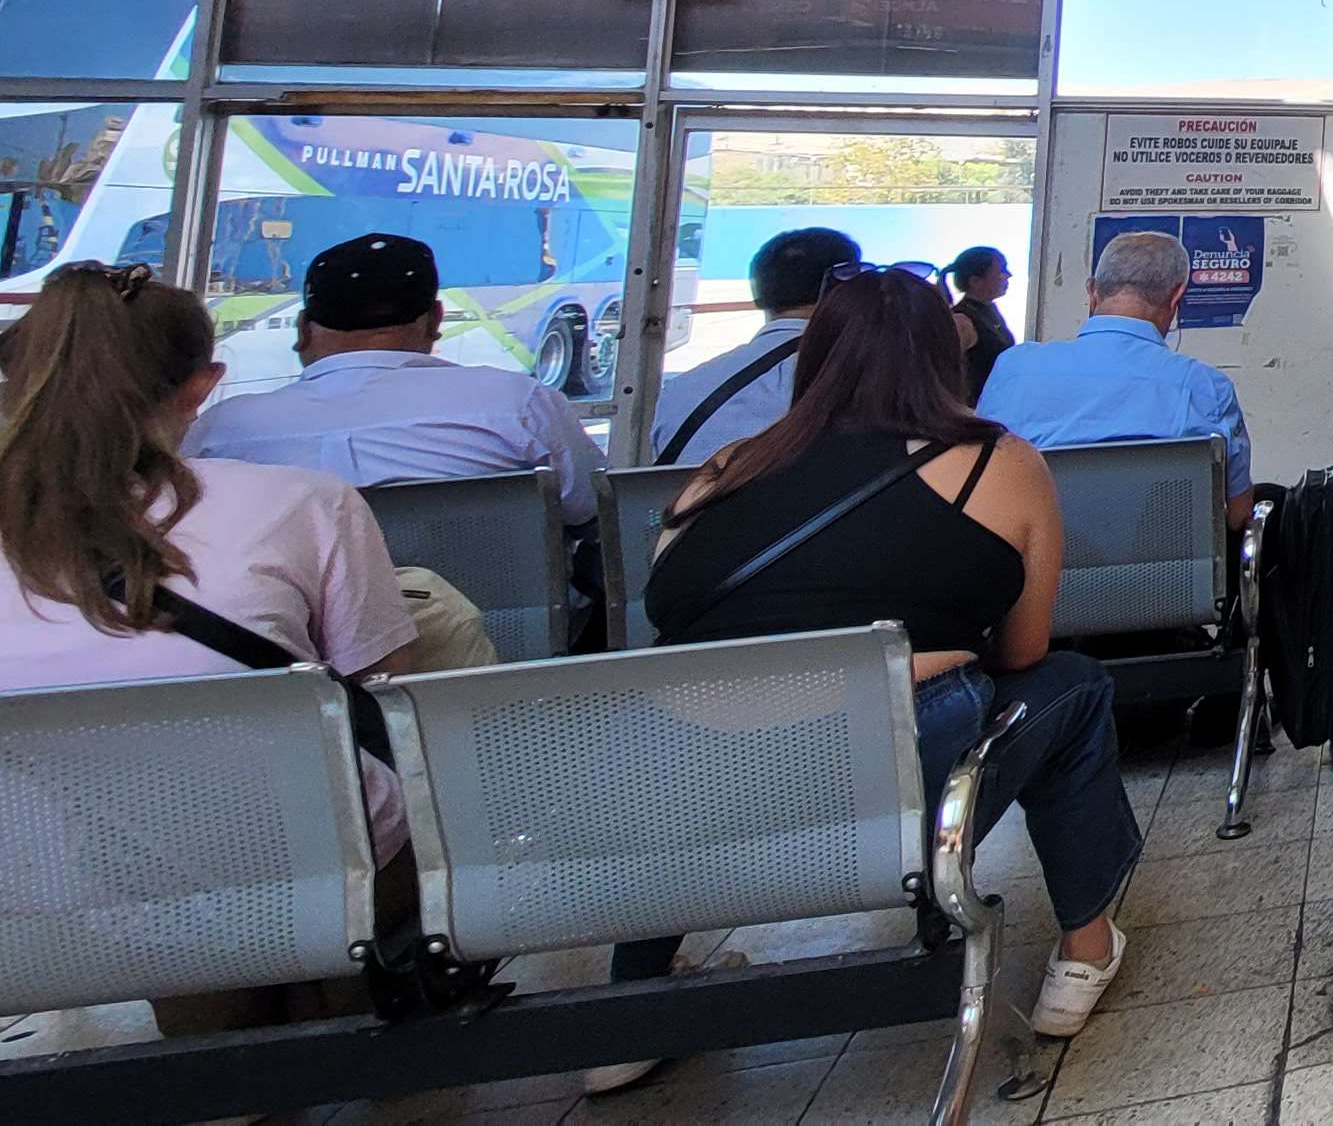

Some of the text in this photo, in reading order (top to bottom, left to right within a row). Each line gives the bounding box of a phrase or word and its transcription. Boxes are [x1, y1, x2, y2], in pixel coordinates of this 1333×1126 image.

[1178, 120, 1257, 133] PRECAUCIÓN
[1129, 137, 1299, 151] EVITE ROBOS CUIDE SU EQUIPAJE
[302, 145, 398, 171] PULLMAN
[1113, 151, 1314, 165] NO UTILICE VOCEROS O REVENDEDORES
[1186, 174, 1243, 183] CAUTION
[1119, 188, 1143, 196] AVOID
[1145, 188, 1169, 196] THEFT
[1171, 188, 1187, 196] AND
[1189, 188, 1209, 196] TAKE
[1210, 188, 1230, 196] CARE
[1233, 188, 1243, 196] OF
[1245, 188, 1265, 196] YOUR
[1109, 197, 1121, 205] DO
[1123, 197, 1138, 205] NOT
[1141, 197, 1155, 205] USE
[1193, 249, 1250, 259] Denuncia
[1191, 259, 1251, 269] SEGURO
